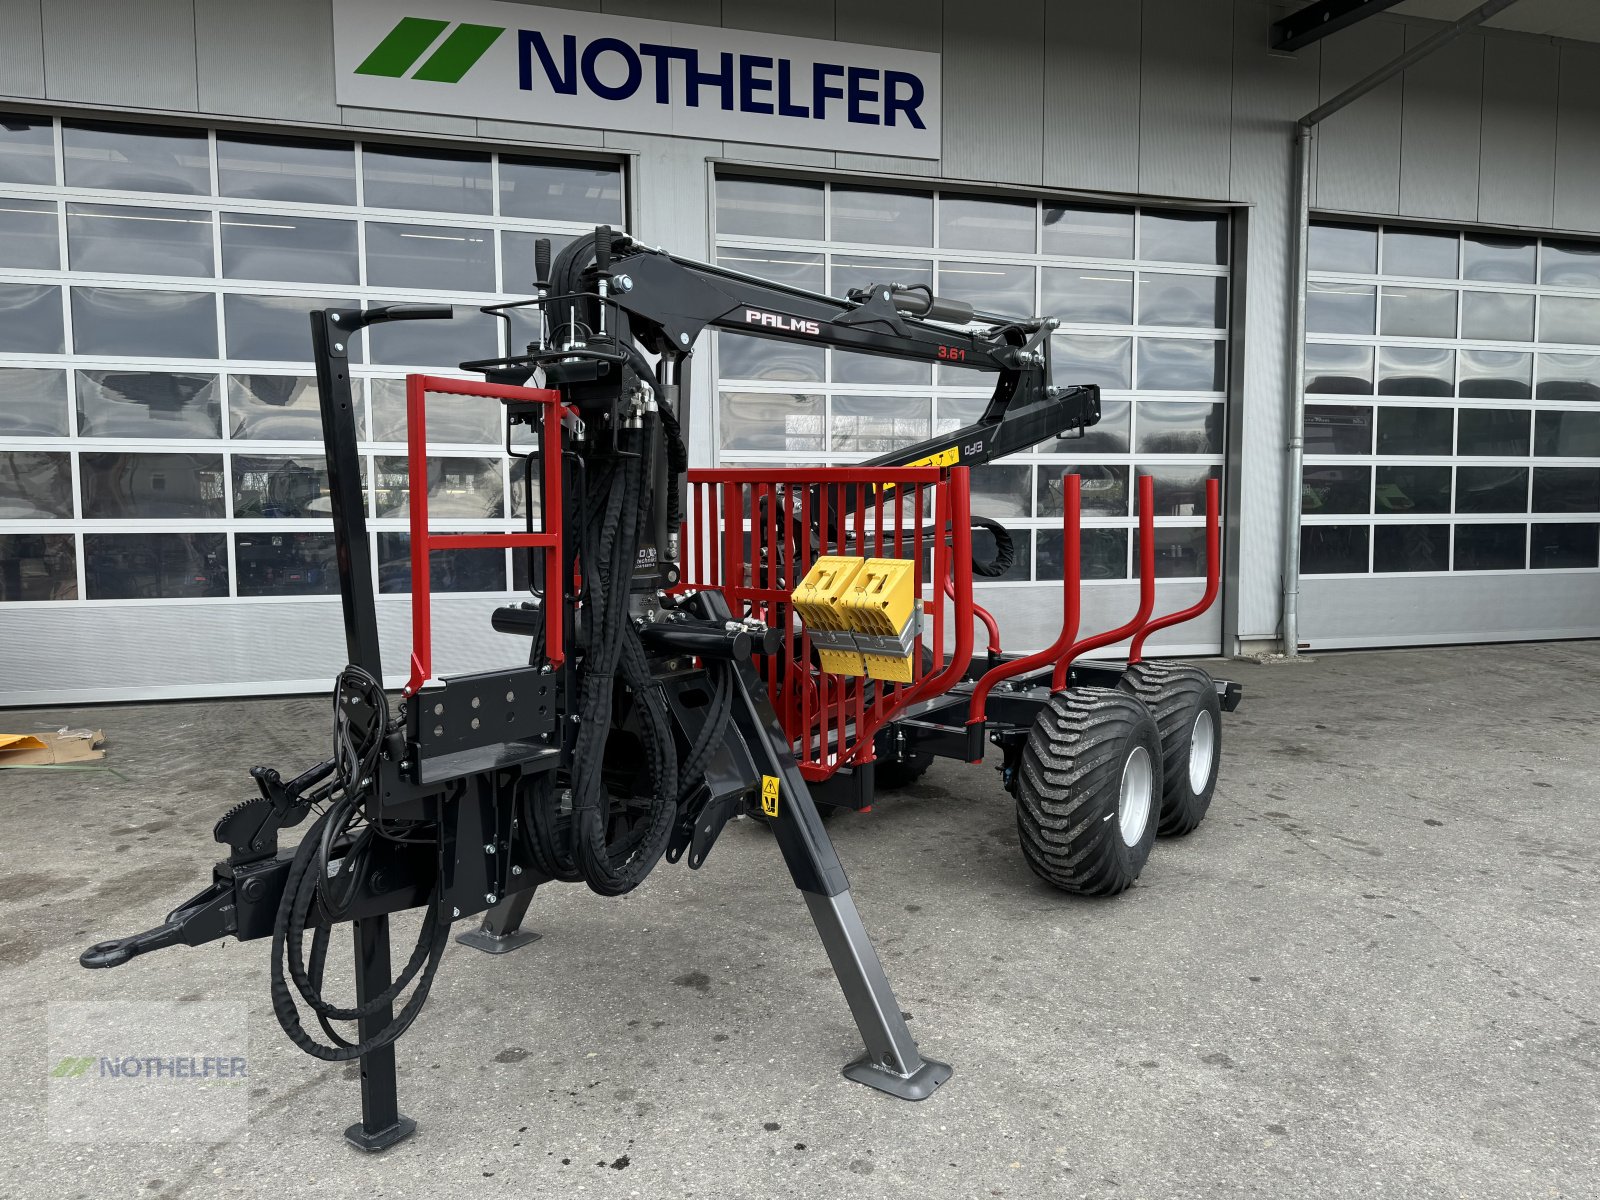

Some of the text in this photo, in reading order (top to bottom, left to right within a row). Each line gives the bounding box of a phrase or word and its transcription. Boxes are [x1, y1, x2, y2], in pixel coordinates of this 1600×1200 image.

[517, 28, 927, 130] NOTHELFER
[745, 308, 820, 335] PALMS
[937, 345, 966, 362] 3.61
